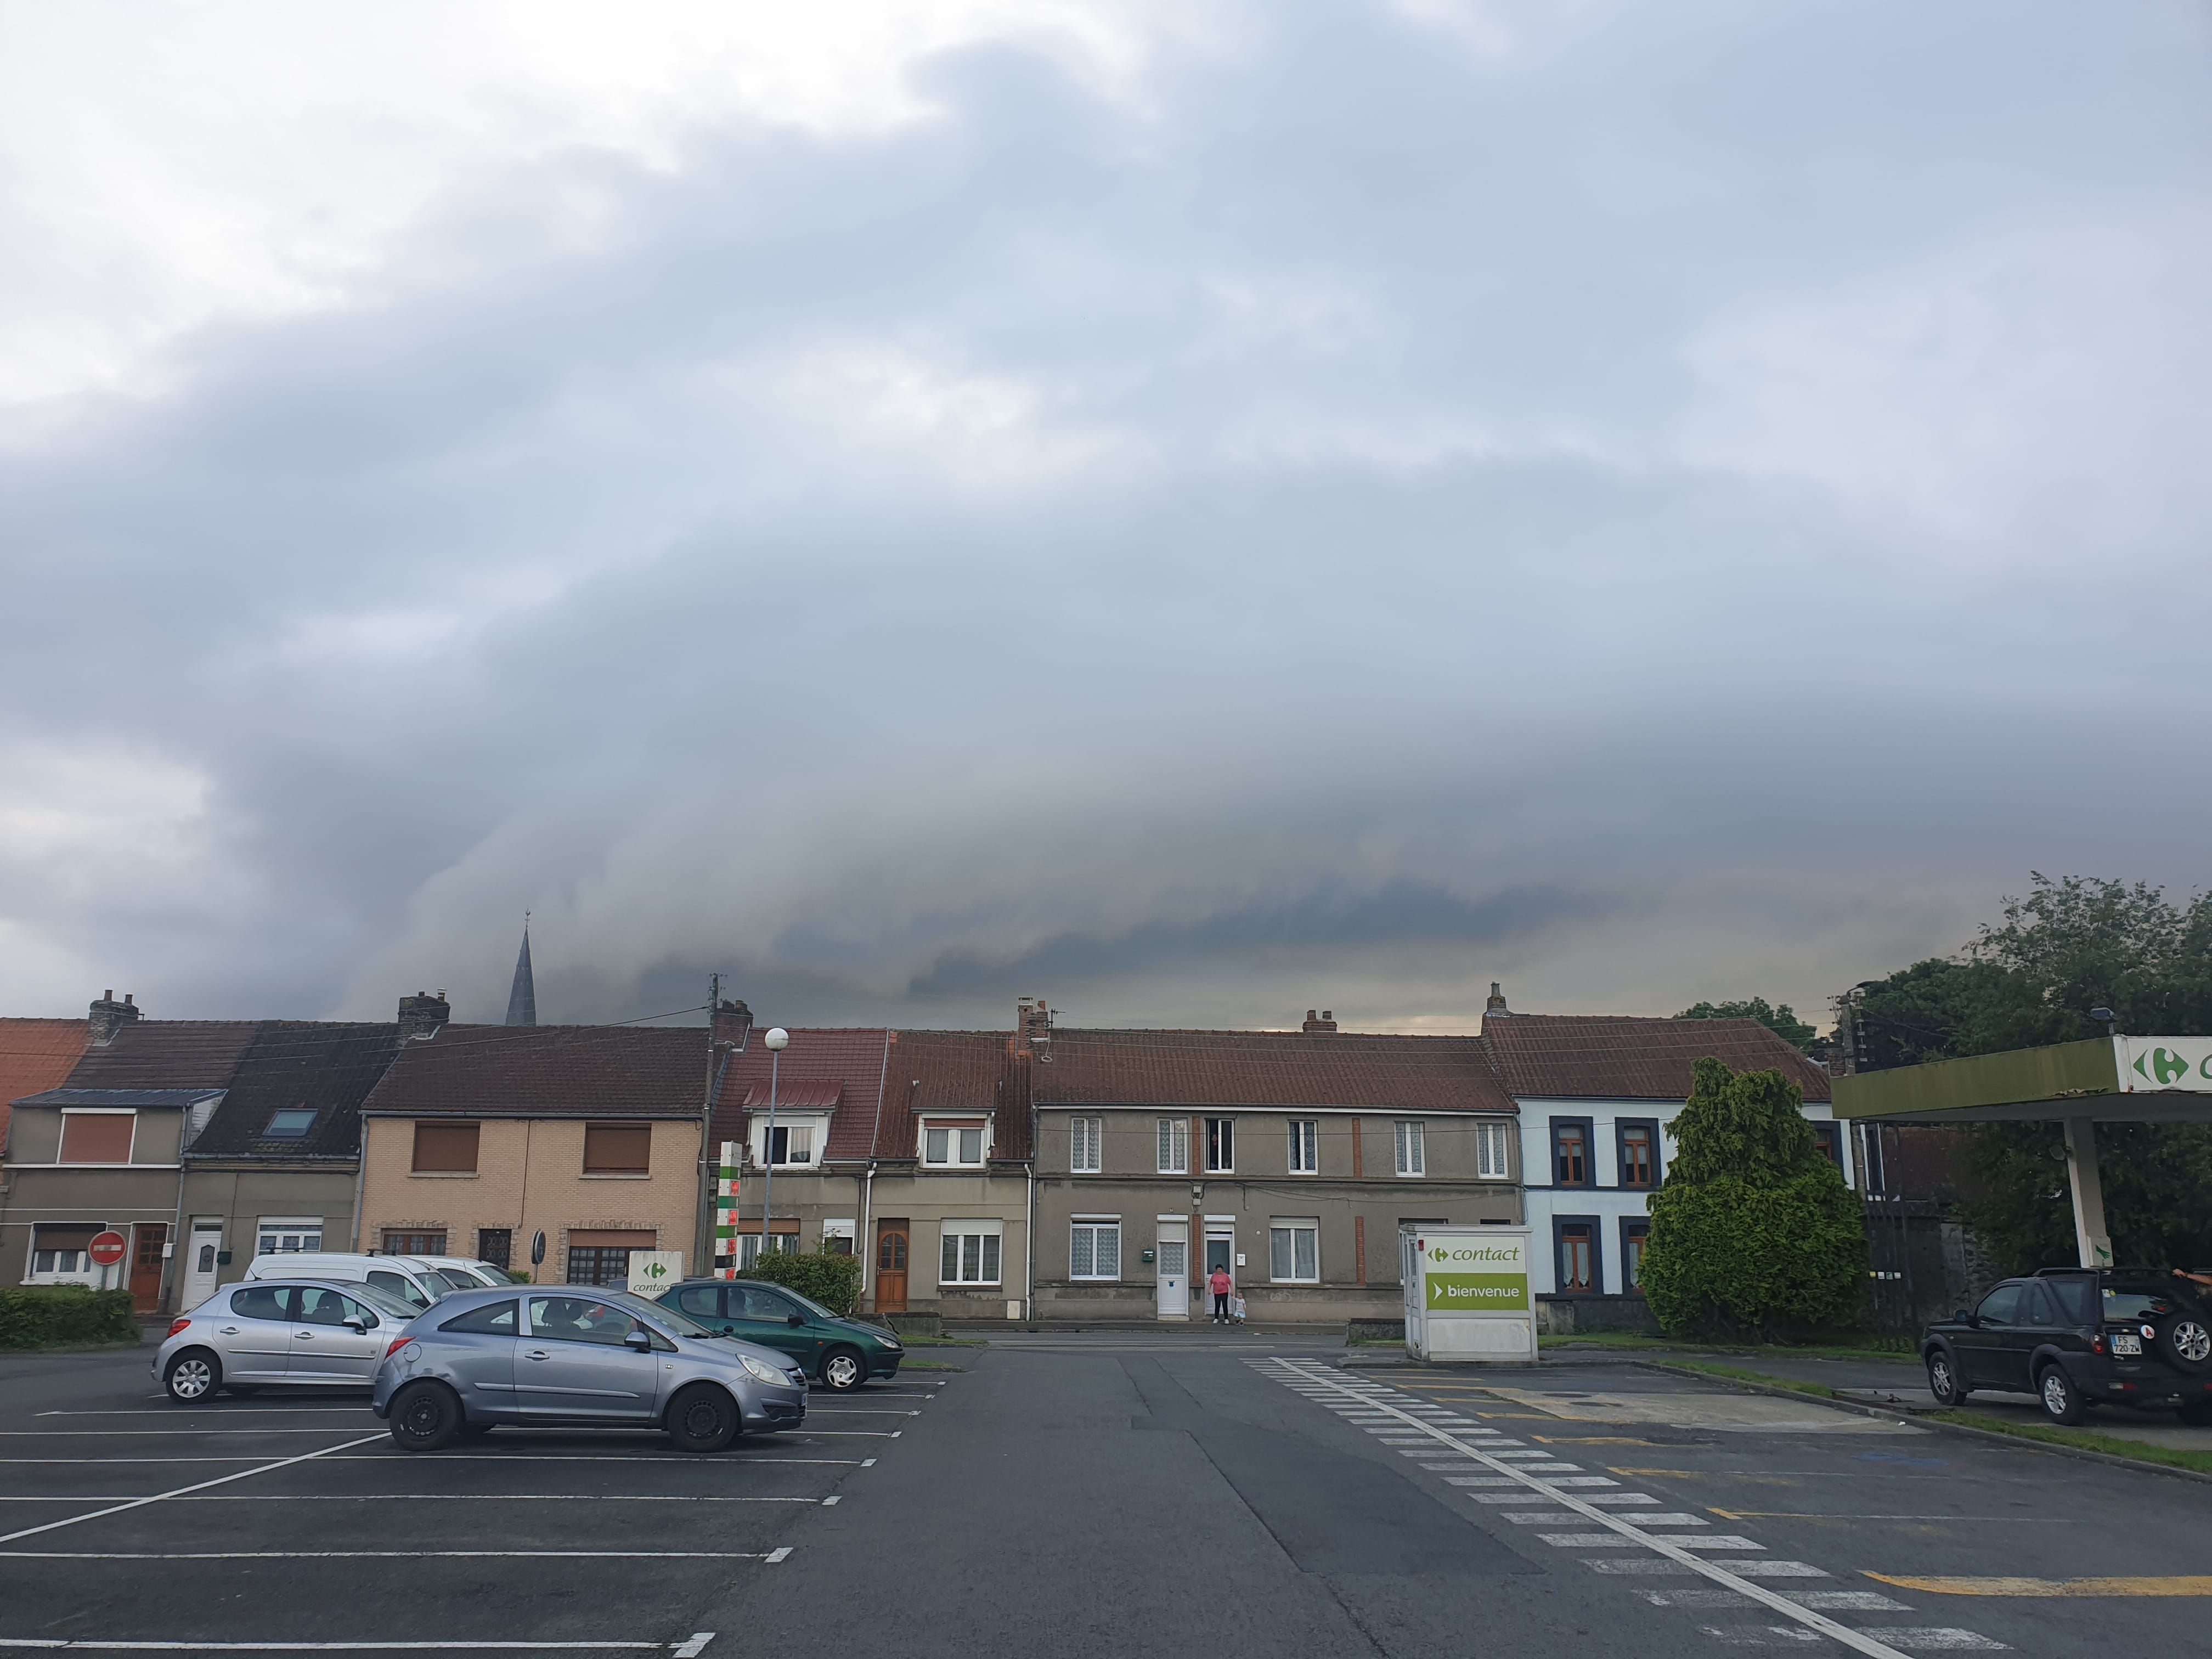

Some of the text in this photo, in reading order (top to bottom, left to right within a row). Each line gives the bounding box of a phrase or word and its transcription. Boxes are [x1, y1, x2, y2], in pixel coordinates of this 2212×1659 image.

[1452, 1246, 1520, 1261] contact
[633, 1283, 670, 1291] contac
[1447, 1284, 1519, 1297] bienvenue
[2146, 1328, 2153, 1336] A
